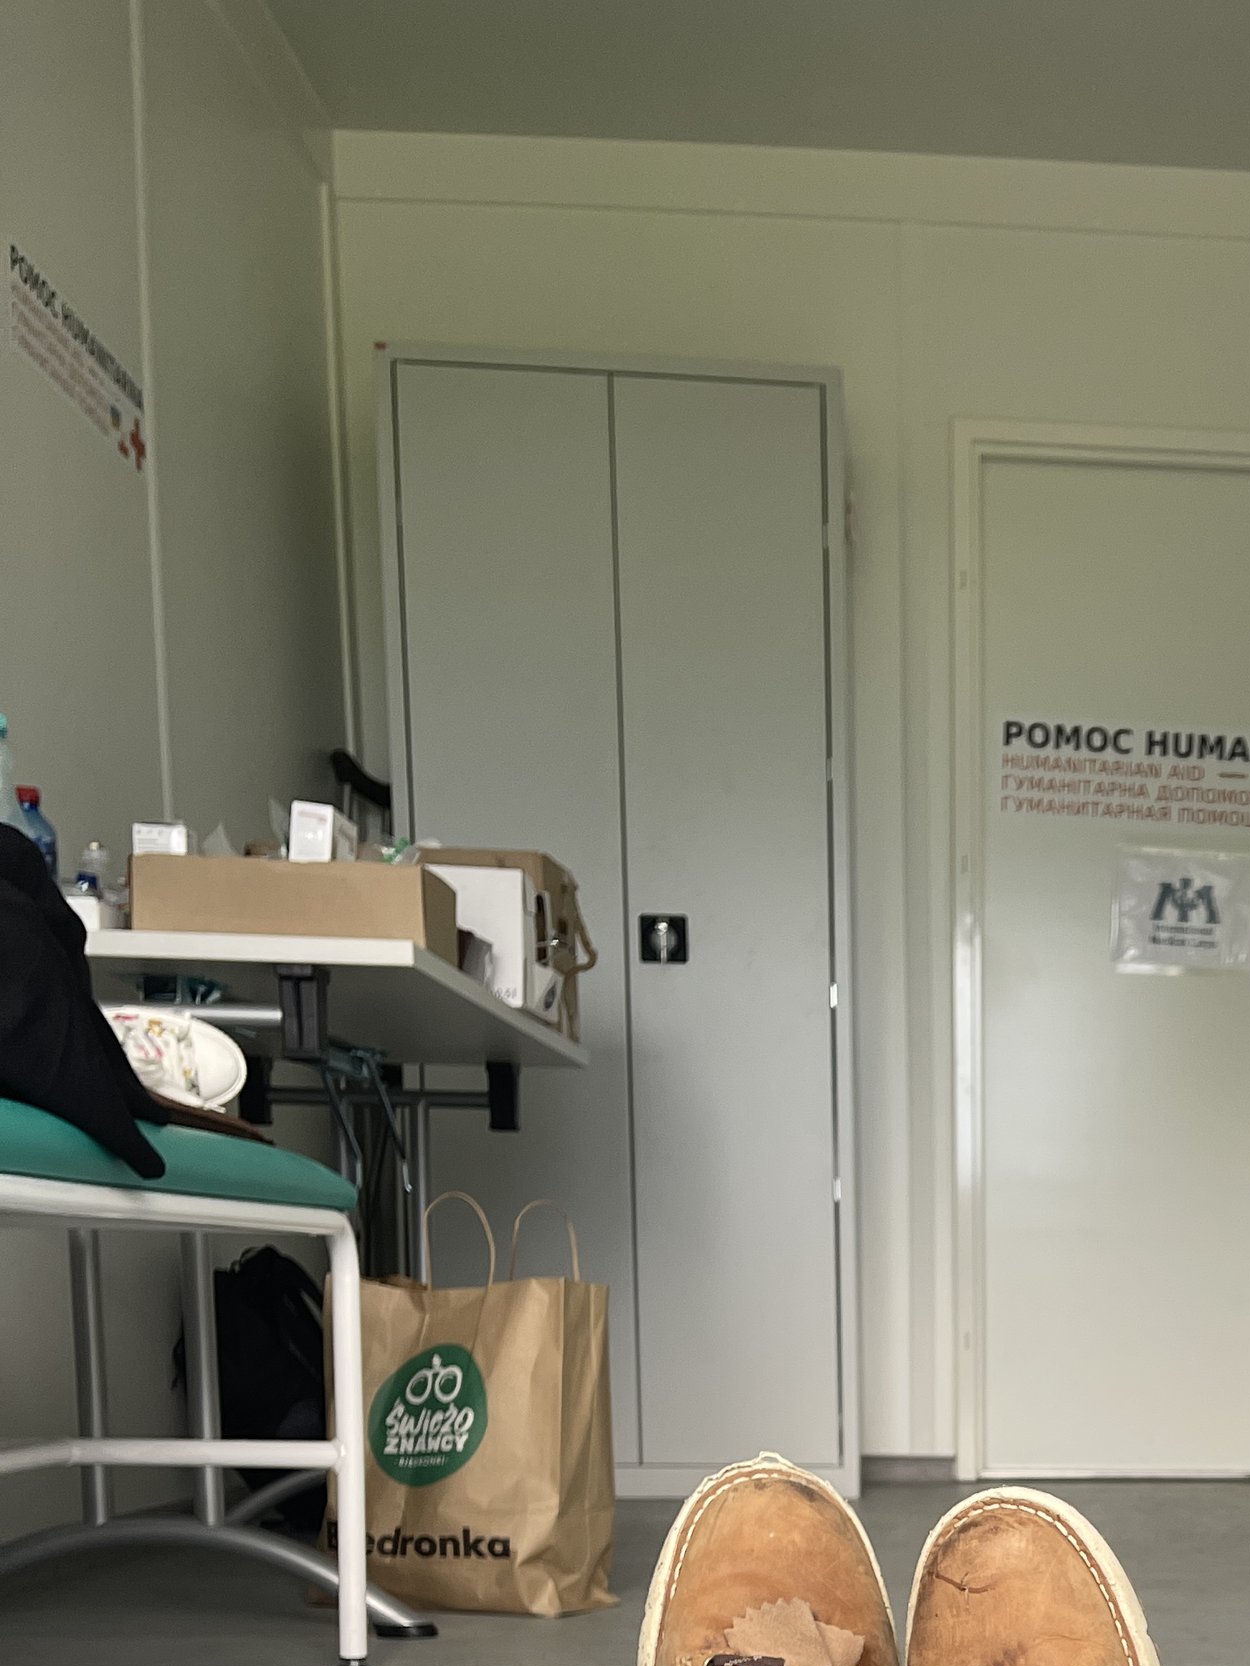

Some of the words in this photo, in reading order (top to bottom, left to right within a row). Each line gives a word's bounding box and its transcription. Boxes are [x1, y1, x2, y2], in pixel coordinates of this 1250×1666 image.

[1002, 720, 1134, 755] POMOC
[1001, 753, 1162, 779] HUMANITARIAN
[1167, 763, 1206, 782] AID
[327, 1521, 511, 1558] dronka
